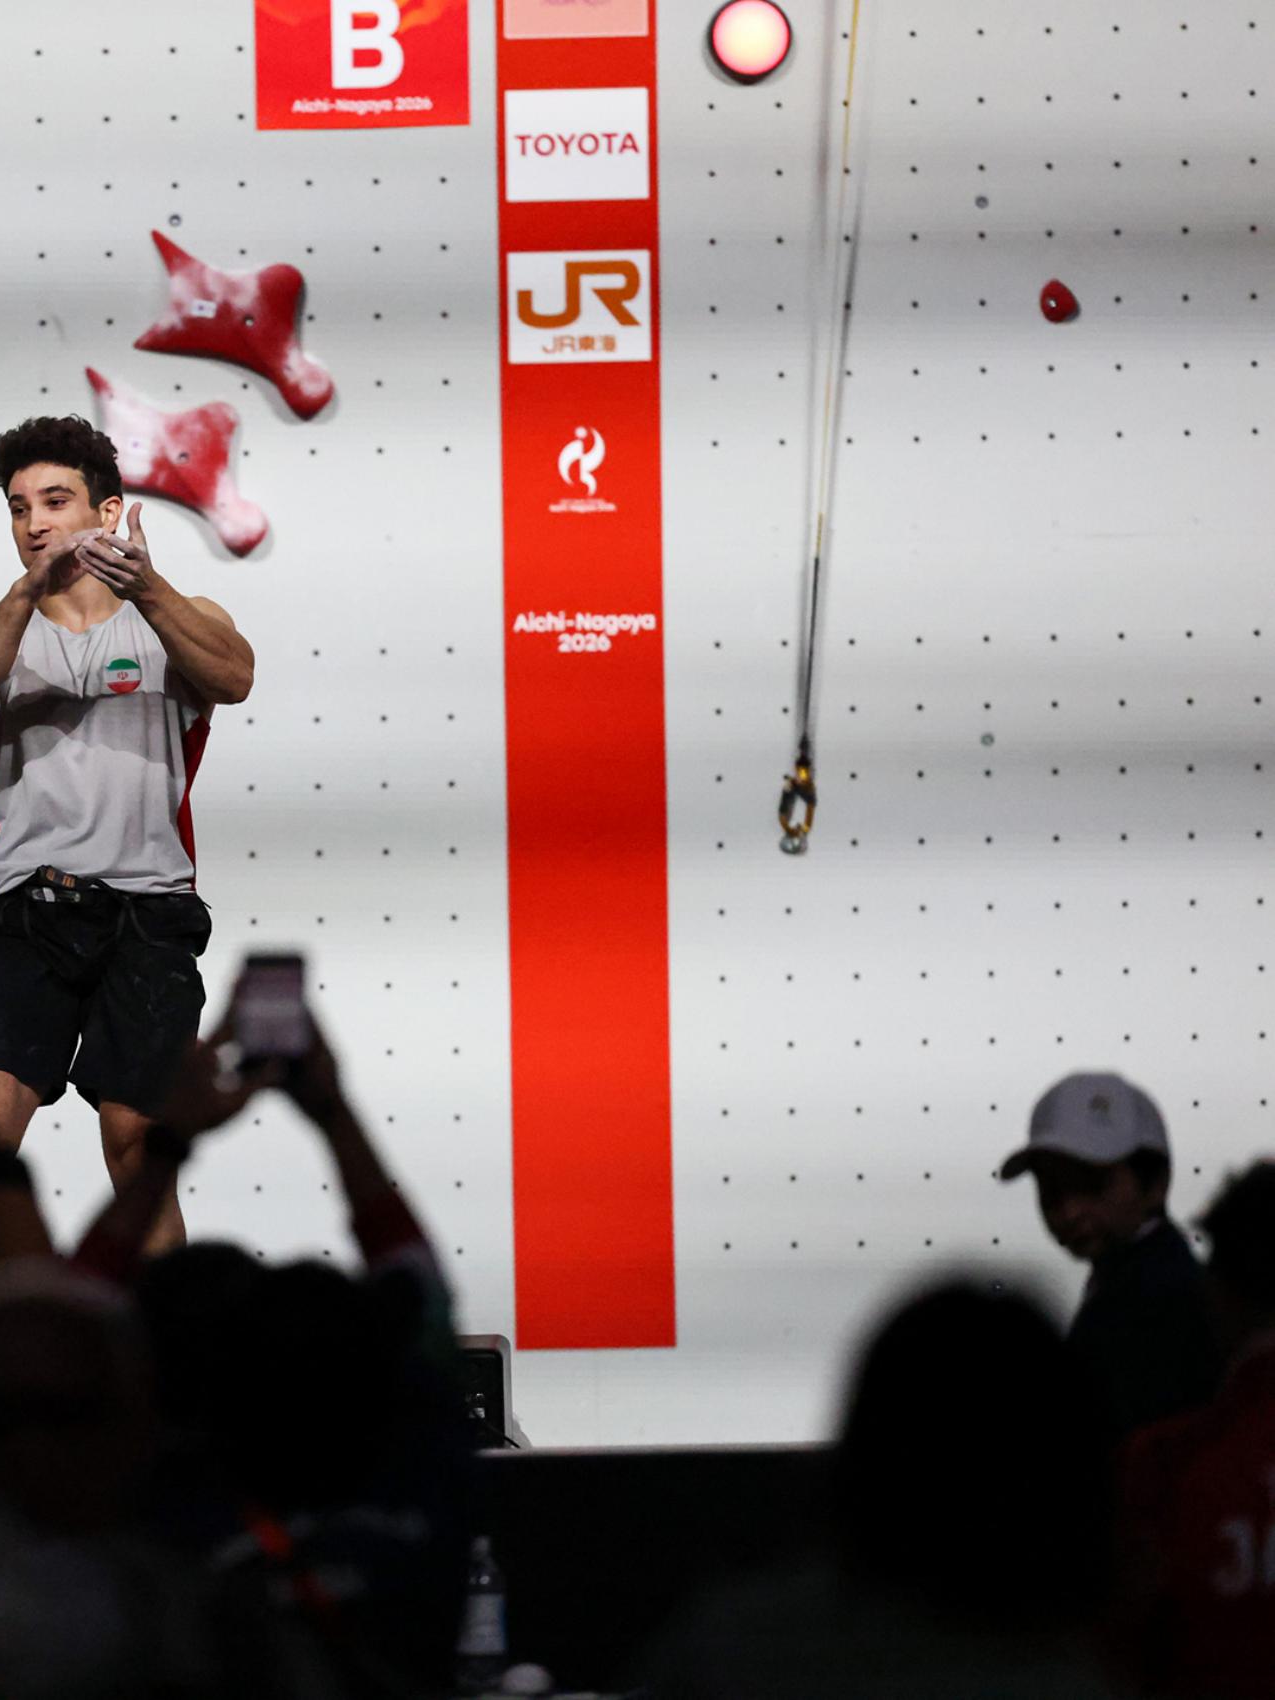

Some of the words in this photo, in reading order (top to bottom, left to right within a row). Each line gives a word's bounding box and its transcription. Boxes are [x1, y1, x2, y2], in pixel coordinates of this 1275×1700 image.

[330, 0, 404, 89] B
[292, 98, 393, 116] Aichi-Nagoya
[394, 96, 433, 111] 2026
[515, 132, 640, 156] TOYOTA
[517, 259, 641, 329] JR
[513, 610, 657, 636] Aichi-Nagoya
[557, 632, 612, 653] 2026
